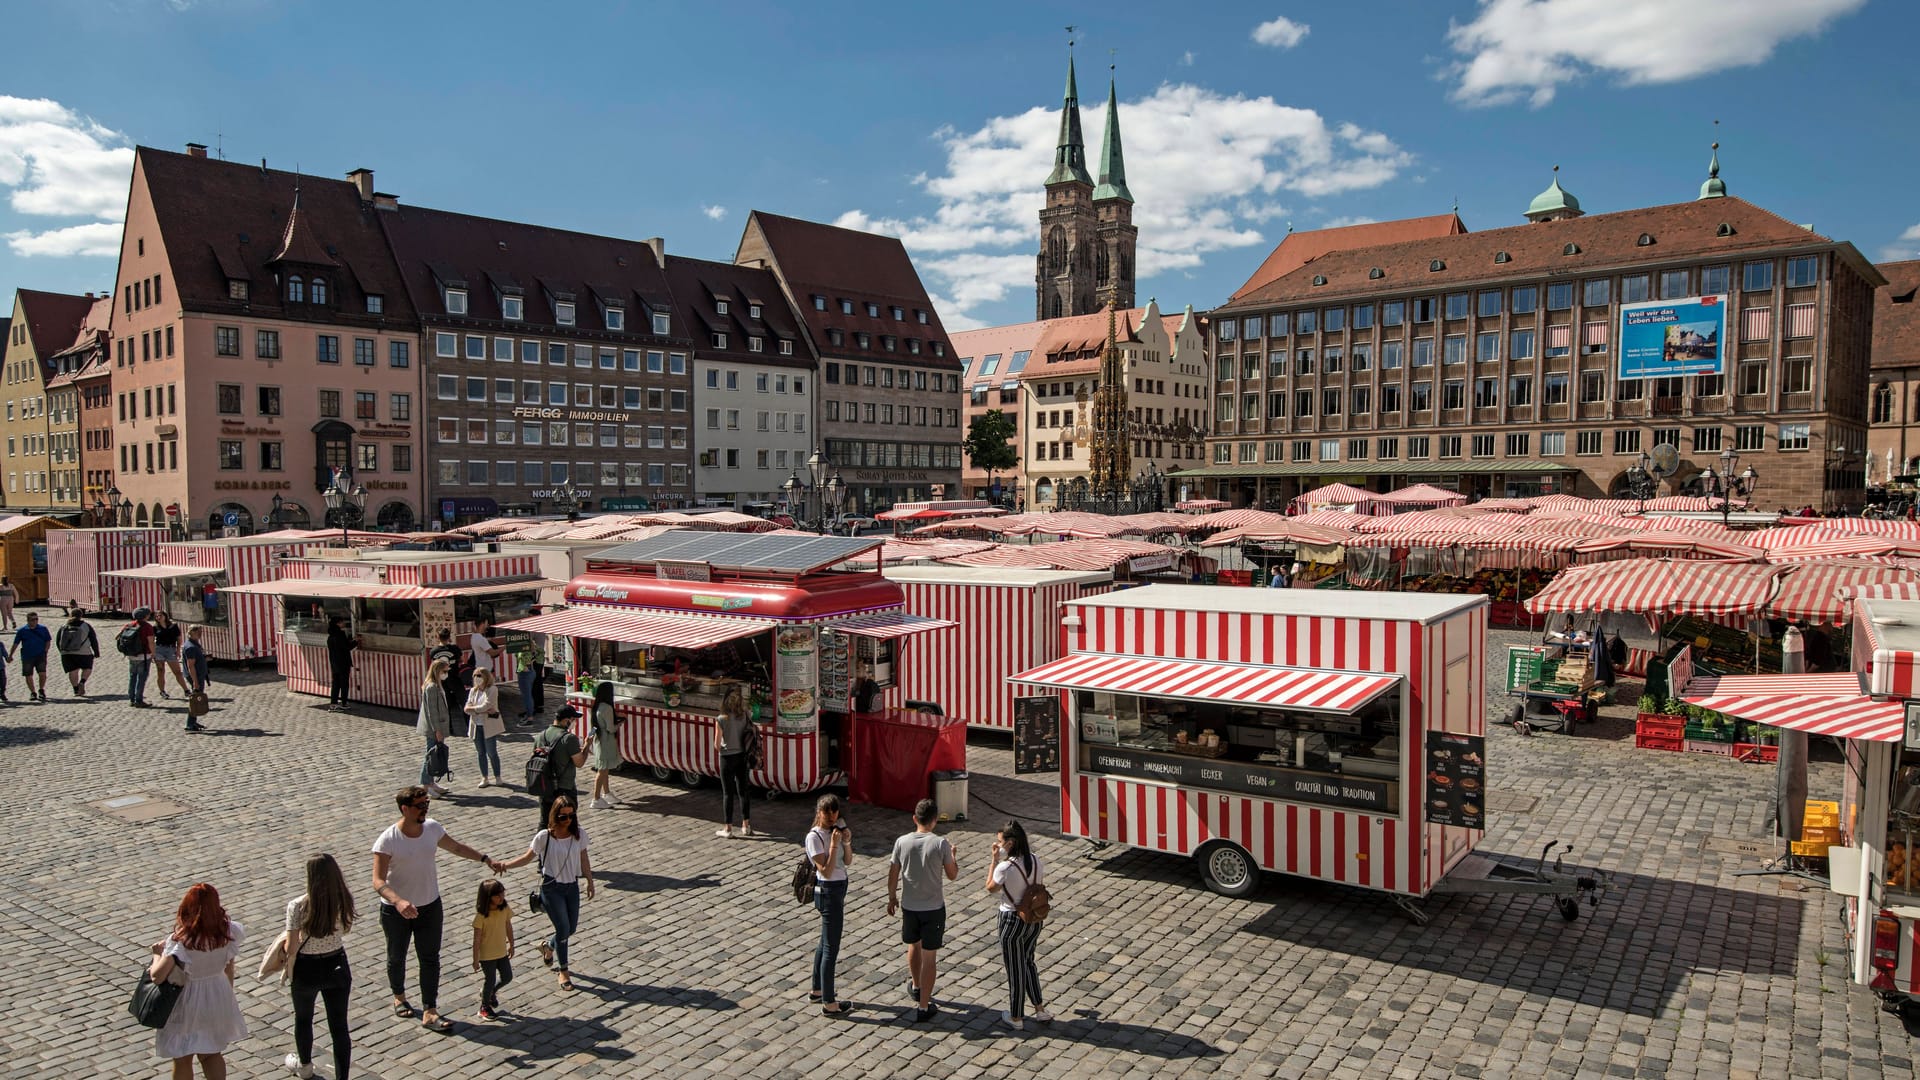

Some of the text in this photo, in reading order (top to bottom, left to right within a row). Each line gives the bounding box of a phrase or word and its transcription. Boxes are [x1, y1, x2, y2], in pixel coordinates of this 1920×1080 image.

[568, 410, 629, 422] IMMOBILIEN
[329, 566, 361, 579] FALAFEL
[661, 567, 686, 576] FALAFEL
[595, 583, 629, 601] Palmyra
[1098, 755, 1376, 801] OFENFRISCH HAUSGEMACHT LECKER VEGAN QUALITÄT UND TRADITION
